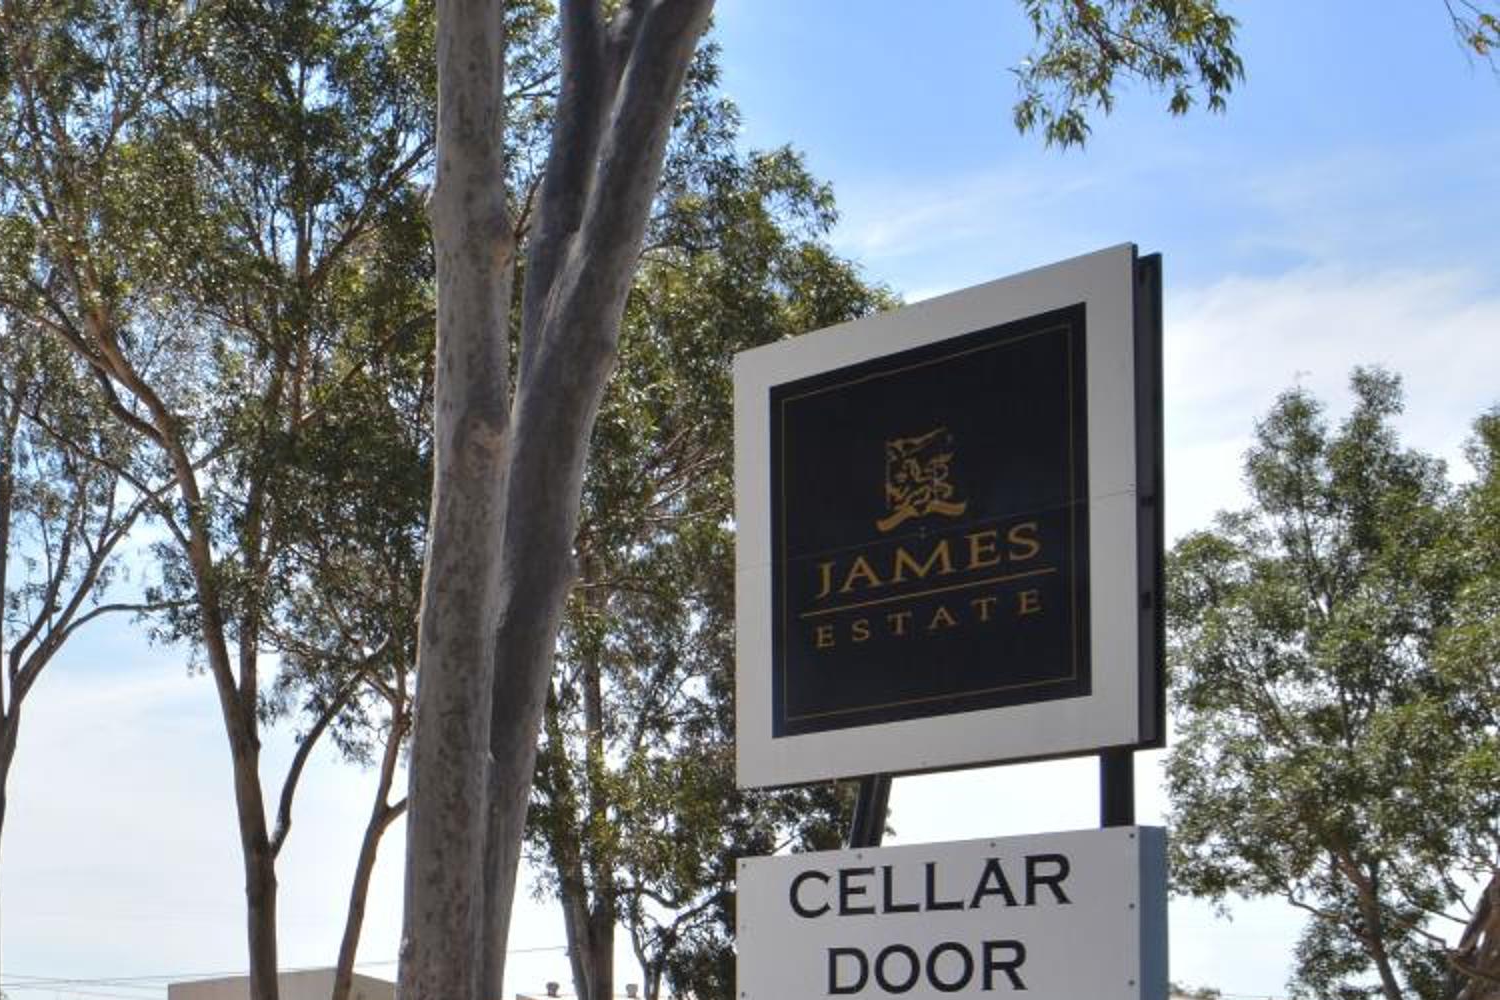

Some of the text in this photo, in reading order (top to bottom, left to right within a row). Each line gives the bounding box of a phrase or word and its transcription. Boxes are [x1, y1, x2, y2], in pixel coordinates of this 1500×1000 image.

[815, 521, 1041, 598] JAMES
[816, 591, 1042, 648] ESTATE
[789, 853, 1072, 919] CELLAR
[827, 939, 1028, 995] DOOR
